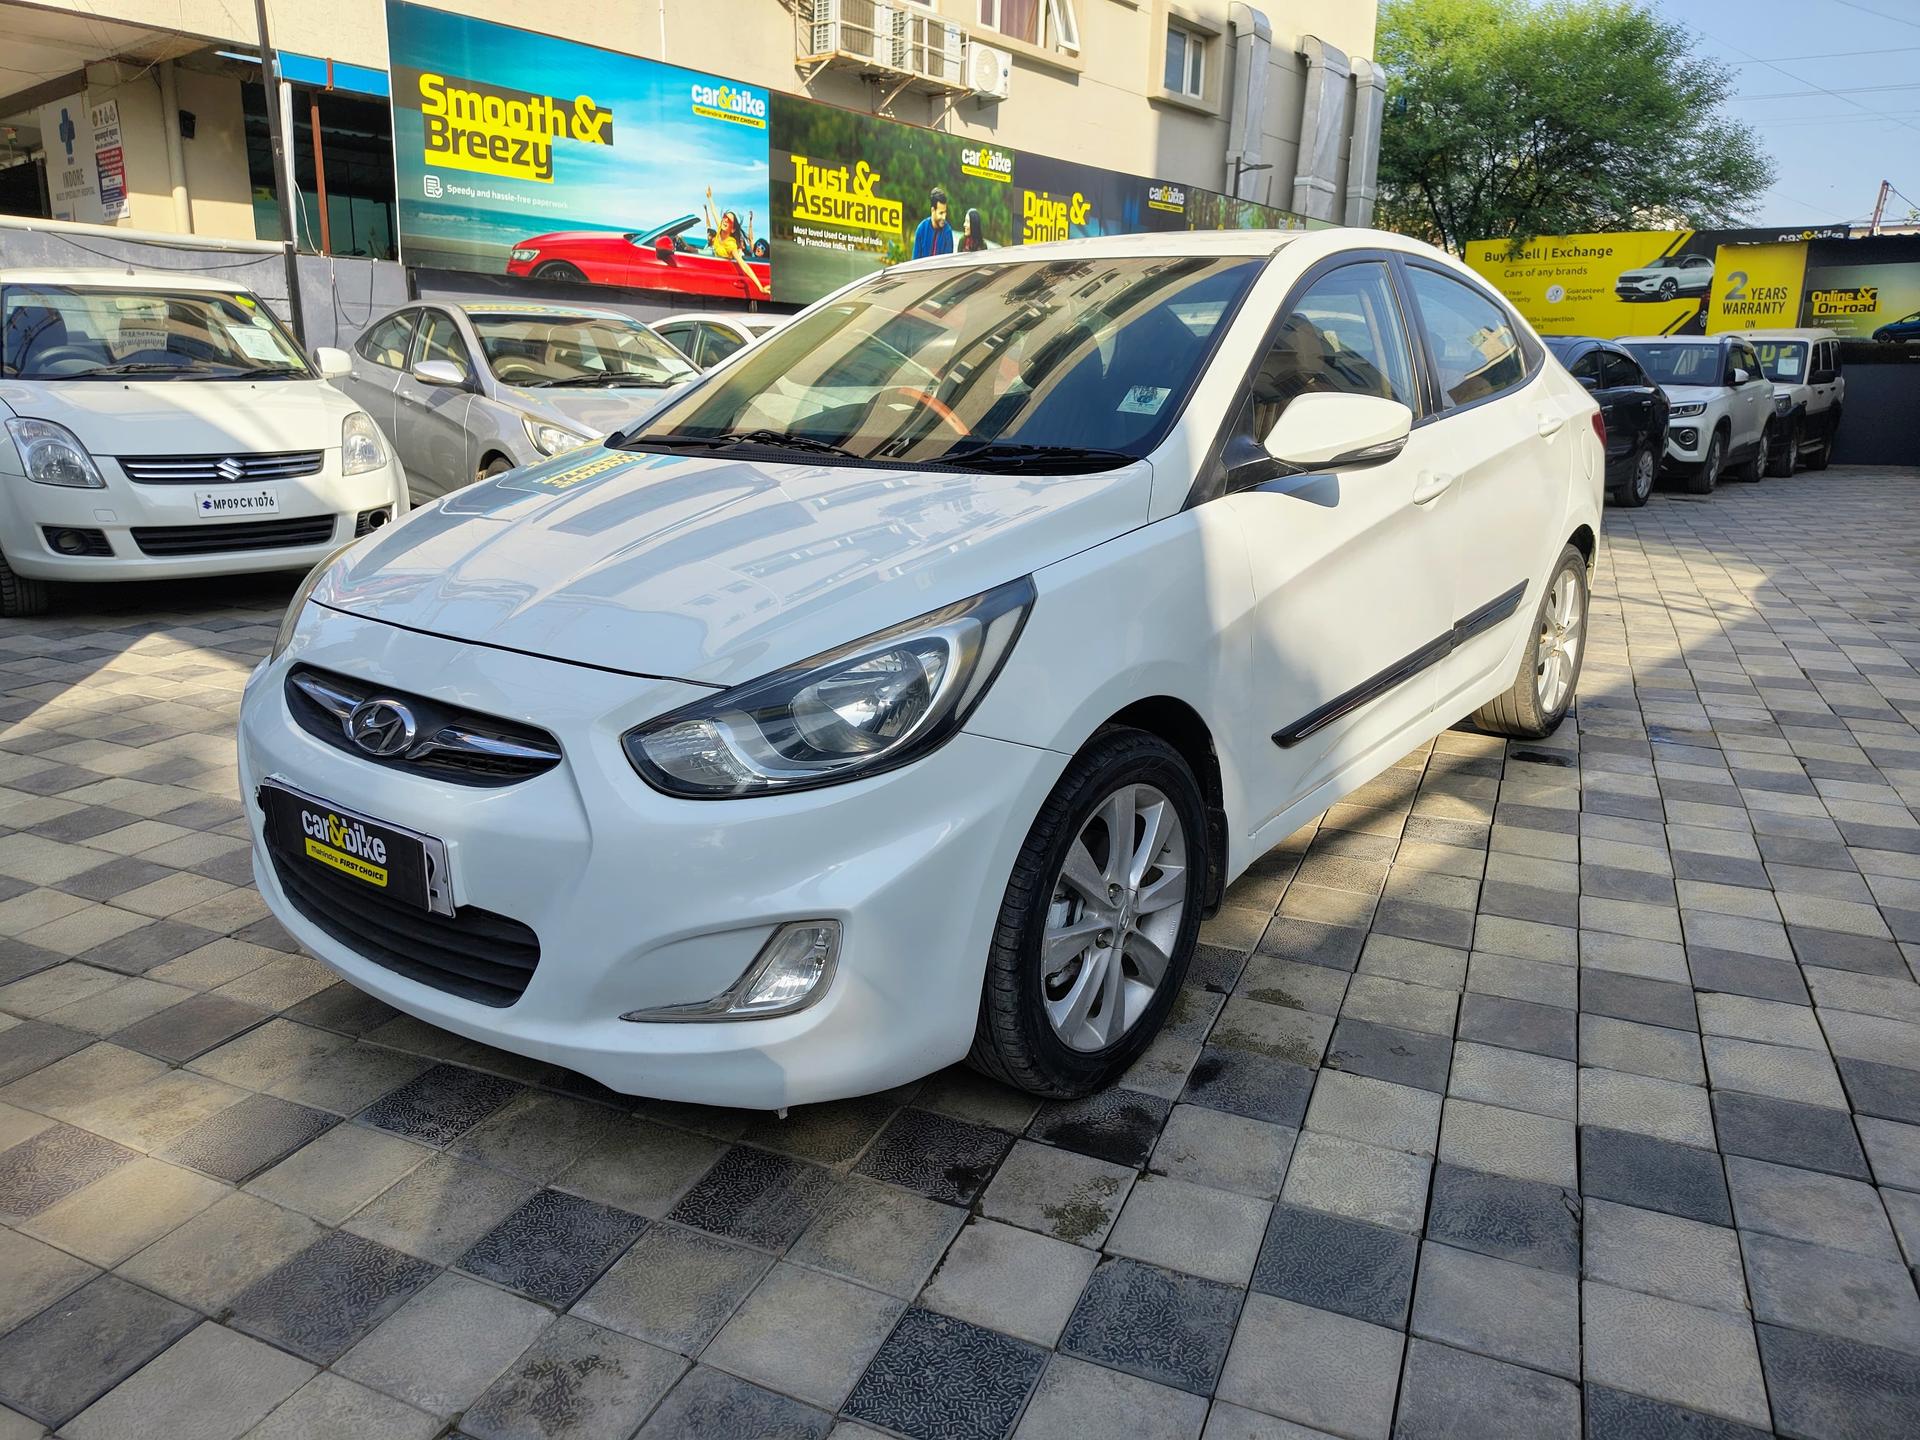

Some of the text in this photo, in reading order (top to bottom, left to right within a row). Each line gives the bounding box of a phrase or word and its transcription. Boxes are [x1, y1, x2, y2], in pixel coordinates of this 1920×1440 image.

[418, 73, 612, 145] Smooth &
[691, 84, 766, 117] car&bike
[723, 113, 739, 122] FIRST
[423, 114, 553, 180] Breezy
[961, 148, 1011, 173] car&bike
[62, 168, 85, 189] INDORE
[790, 154, 880, 198] Trust &
[446, 184, 475, 198] Speedy
[476, 189, 490, 198] and
[492, 190, 531, 204] hassle-free
[793, 185, 900, 228] Assurance
[1023, 190, 1091, 225] Drive &
[793, 225, 883, 246] Most loved Used Car brand of India
[1023, 216, 1067, 241] Smile
[797, 236, 805, 247] By
[806, 237, 831, 249] Franchise
[847, 243, 855, 252] ET
[1484, 251, 1505, 263] Buy
[1517, 248, 1540, 260] Sell
[1551, 246, 1614, 259] Exchange
[1504, 266, 1588, 278] Cars of any brands
[1567, 287, 1605, 295] Guaranteed
[1724, 270, 1788, 301] 2 YEARS
[1811, 285, 1878, 302] Online &
[1566, 294, 1593, 303] Buyback
[1722, 302, 1786, 315] WARRANTY
[1818, 301, 1876, 314] On-road
[1744, 320, 1756, 329] ON
[301, 809, 387, 865] car&bike
[310, 845, 384, 881] Mahindra FIRST CHOICE
